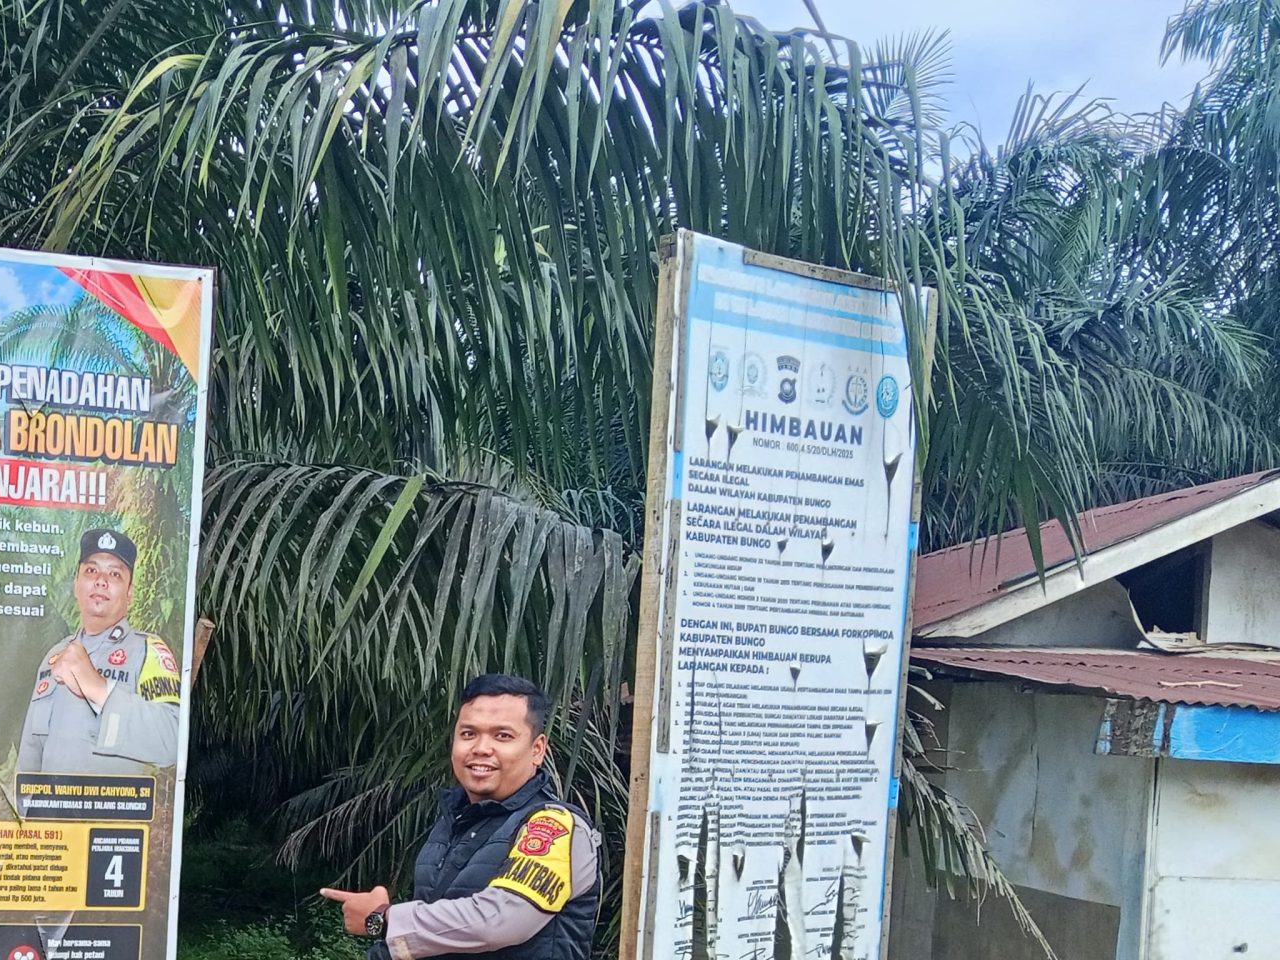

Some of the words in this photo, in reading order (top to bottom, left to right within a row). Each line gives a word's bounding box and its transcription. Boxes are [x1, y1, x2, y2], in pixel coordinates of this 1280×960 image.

[9, 408, 178, 465] BRONDOLAN
[745, 410, 863, 446] HIMBAUAN
[752, 437, 781, 451] NOMOR
[688, 469, 720, 482] SECARA
[722, 475, 750, 487] ILEGAL
[689, 456, 734, 472] LARANGAN
[736, 464, 784, 478] MELAKUKAN
[785, 470, 842, 486] PENAMBANGAN
[844, 476, 864, 488] EMAS
[688, 484, 717, 496] DALAM
[719, 488, 756, 500] WILAYAH
[757, 493, 803, 505] KABUPATEN
[804, 498, 831, 509] BUNGO
[687, 502, 736, 517] LARANGAN
[737, 509, 791, 523] MELAKUKAN
[794, 514, 857, 529] PENAMBANGAN
[15, 520, 64, 535] kebun.
[686, 517, 720, 530] SECARA
[723, 521, 753, 533] ILEGAL
[755, 524, 786, 537] DALAM
[789, 527, 828, 540] WILAYAH
[685, 530, 737, 545] KABUPATEN
[740, 538, 771, 549] BUNGO
[5, 582, 47, 597] dapat
[680, 618, 718, 631] DENGAN
[720, 621, 734, 633] INI,
[736, 622, 767, 634] BUPATI
[769, 625, 798, 635] BUNGO
[801, 627, 839, 638] BERSAMA
[842, 628, 894, 640] FORKOPIMDA
[680, 632, 733, 645] KABUPATEN
[735, 636, 765, 647] BUNGO
[679, 647, 750, 660] MENYAMPAIKAN
[752, 652, 798, 662] HIMBAUAN
[799, 653, 831, 664] BERUPA
[678, 660, 727, 673] LARANGAN
[730, 664, 764, 674] KEPADA
[21, 784, 51, 794] BRIGPOL
[55, 785, 82, 795] WAHYU
[84, 786, 99, 796] DWI
[101, 786, 137, 798] CAHYONO,
[140, 788, 150, 797] SH
[16, 830, 42, 839] (PASAL
[45, 830, 63, 840] 591)
[104, 855, 124, 888] 4
[103, 889, 124, 898] TAHUN
